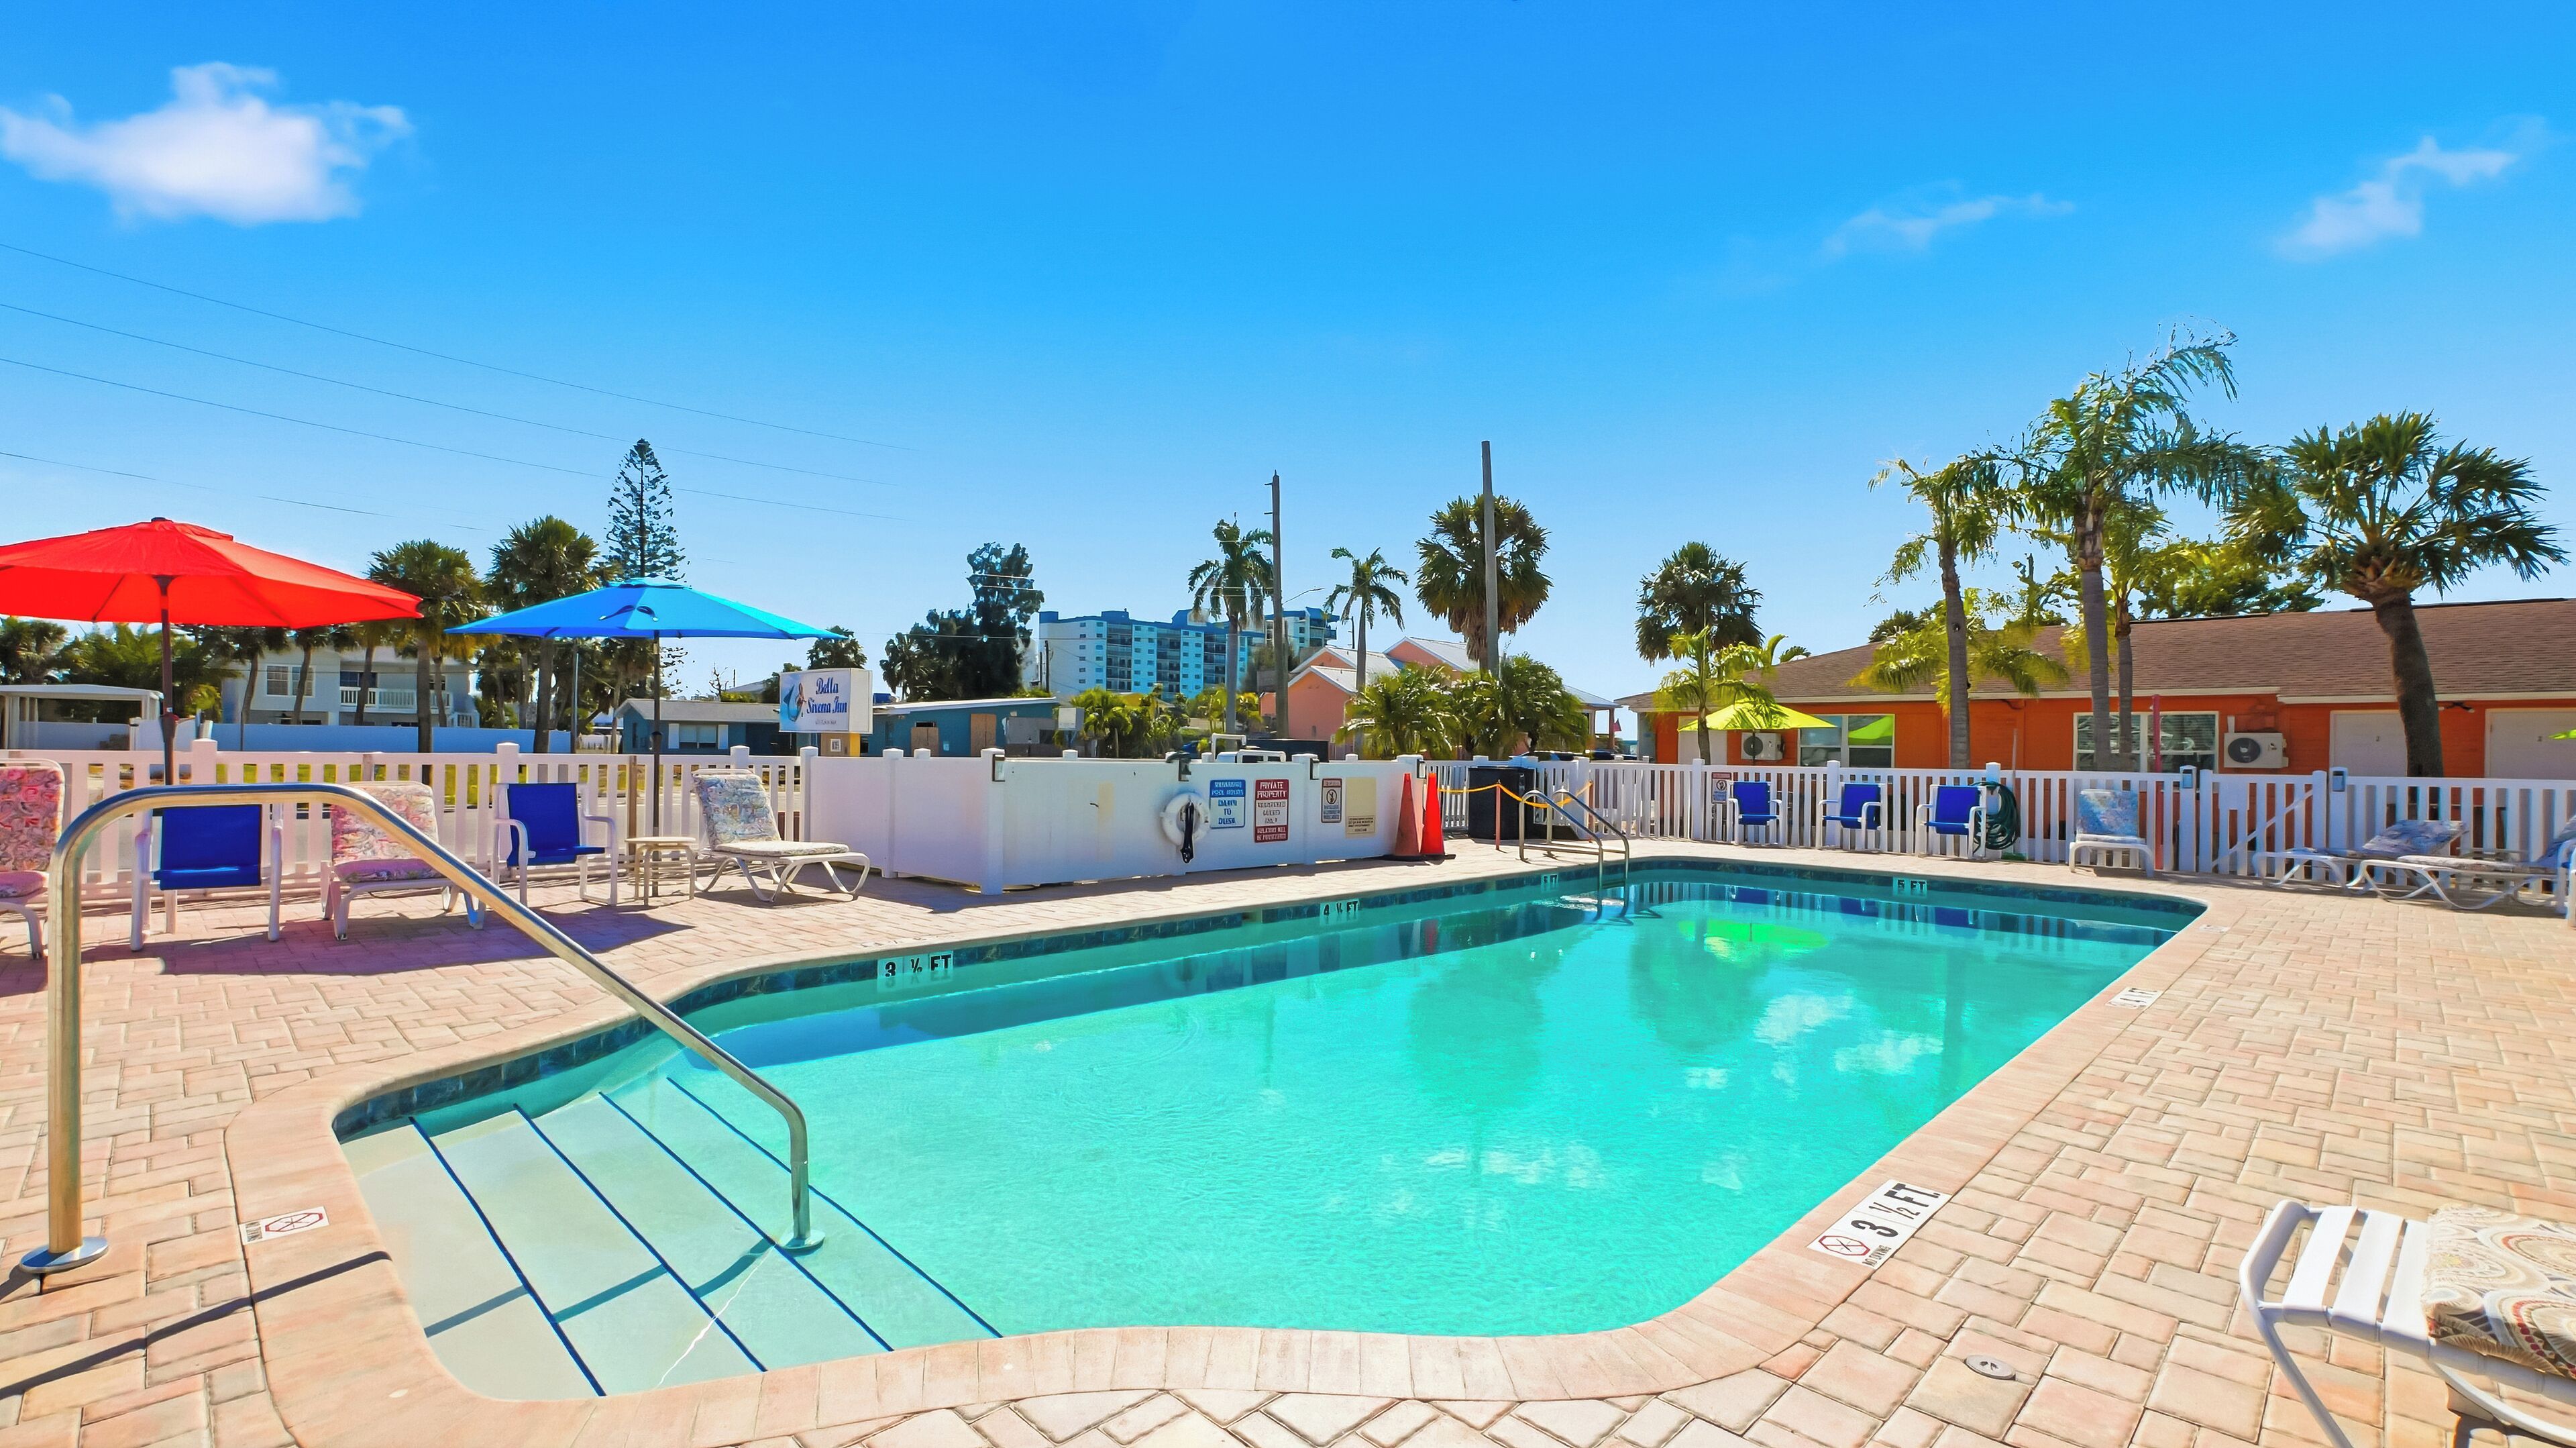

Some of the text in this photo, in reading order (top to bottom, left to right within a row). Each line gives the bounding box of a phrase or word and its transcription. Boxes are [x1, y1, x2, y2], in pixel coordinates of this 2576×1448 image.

[816, 677, 839, 694] Bella
[833, 696, 847, 714] Inn
[1260, 782, 1284, 790] PRIVATE
[1257, 790, 1287, 798] PROPERTY
[1224, 808, 1232, 816] TO
[1910, 880, 1926, 892] FT
[1346, 901, 1358, 913] FT
[885, 962, 896, 977] 3
[930, 954, 952, 971] FT
[1851, 1220, 1899, 1237] 3
